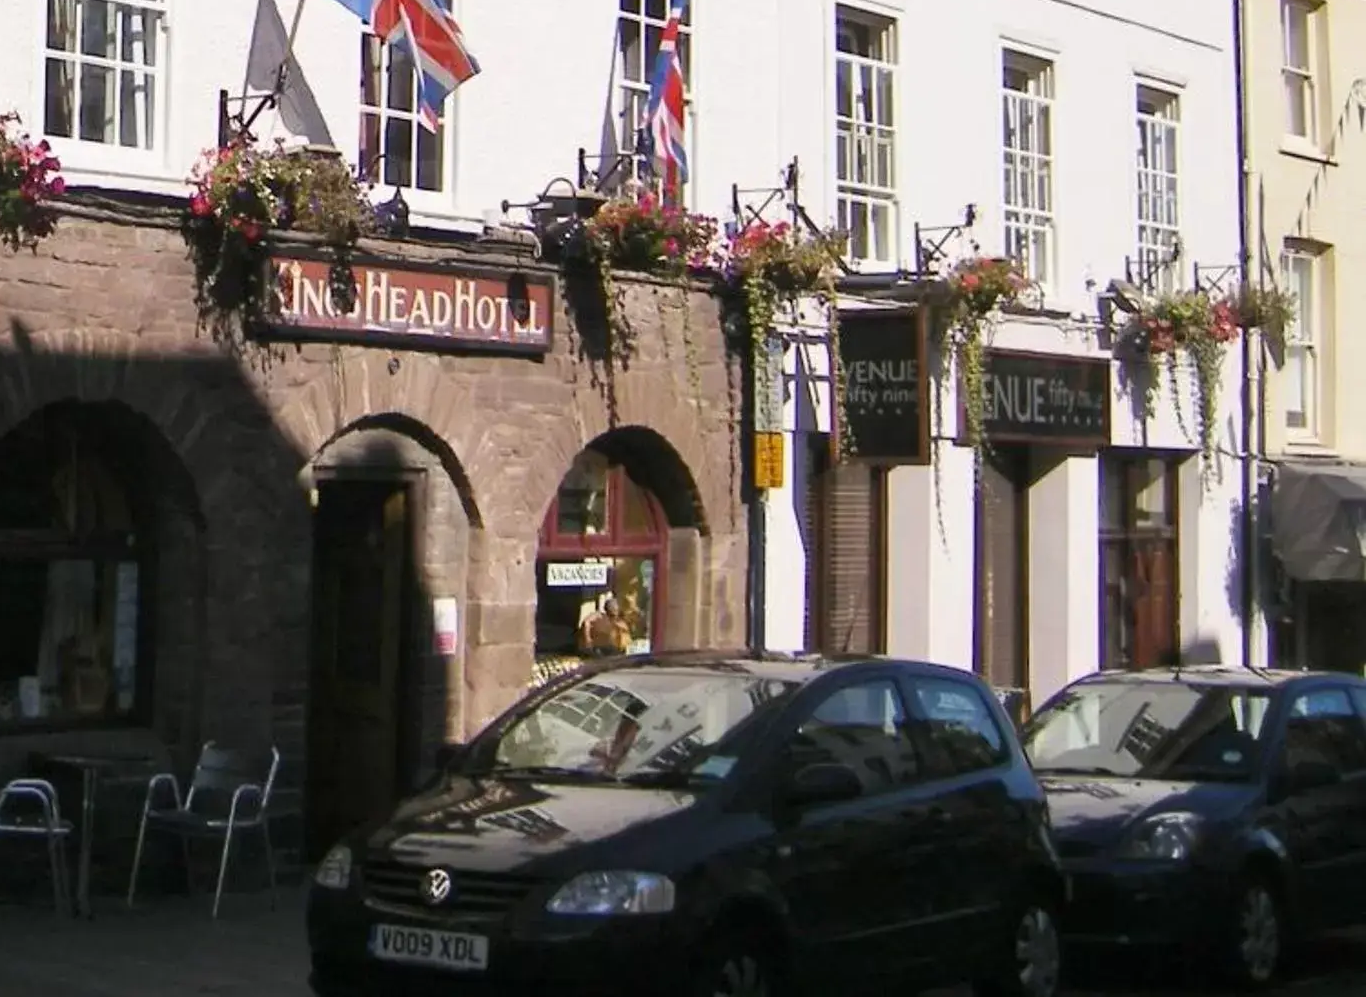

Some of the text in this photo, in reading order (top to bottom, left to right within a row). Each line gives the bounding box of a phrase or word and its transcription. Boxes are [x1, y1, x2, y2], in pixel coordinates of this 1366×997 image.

[366, 271, 452, 327] HEAD
[455, 280, 545, 334] HOTL
[848, 384, 877, 409] ifty
[981, 374, 1046, 423] ENUE
[439, 934, 482, 963] XDL
